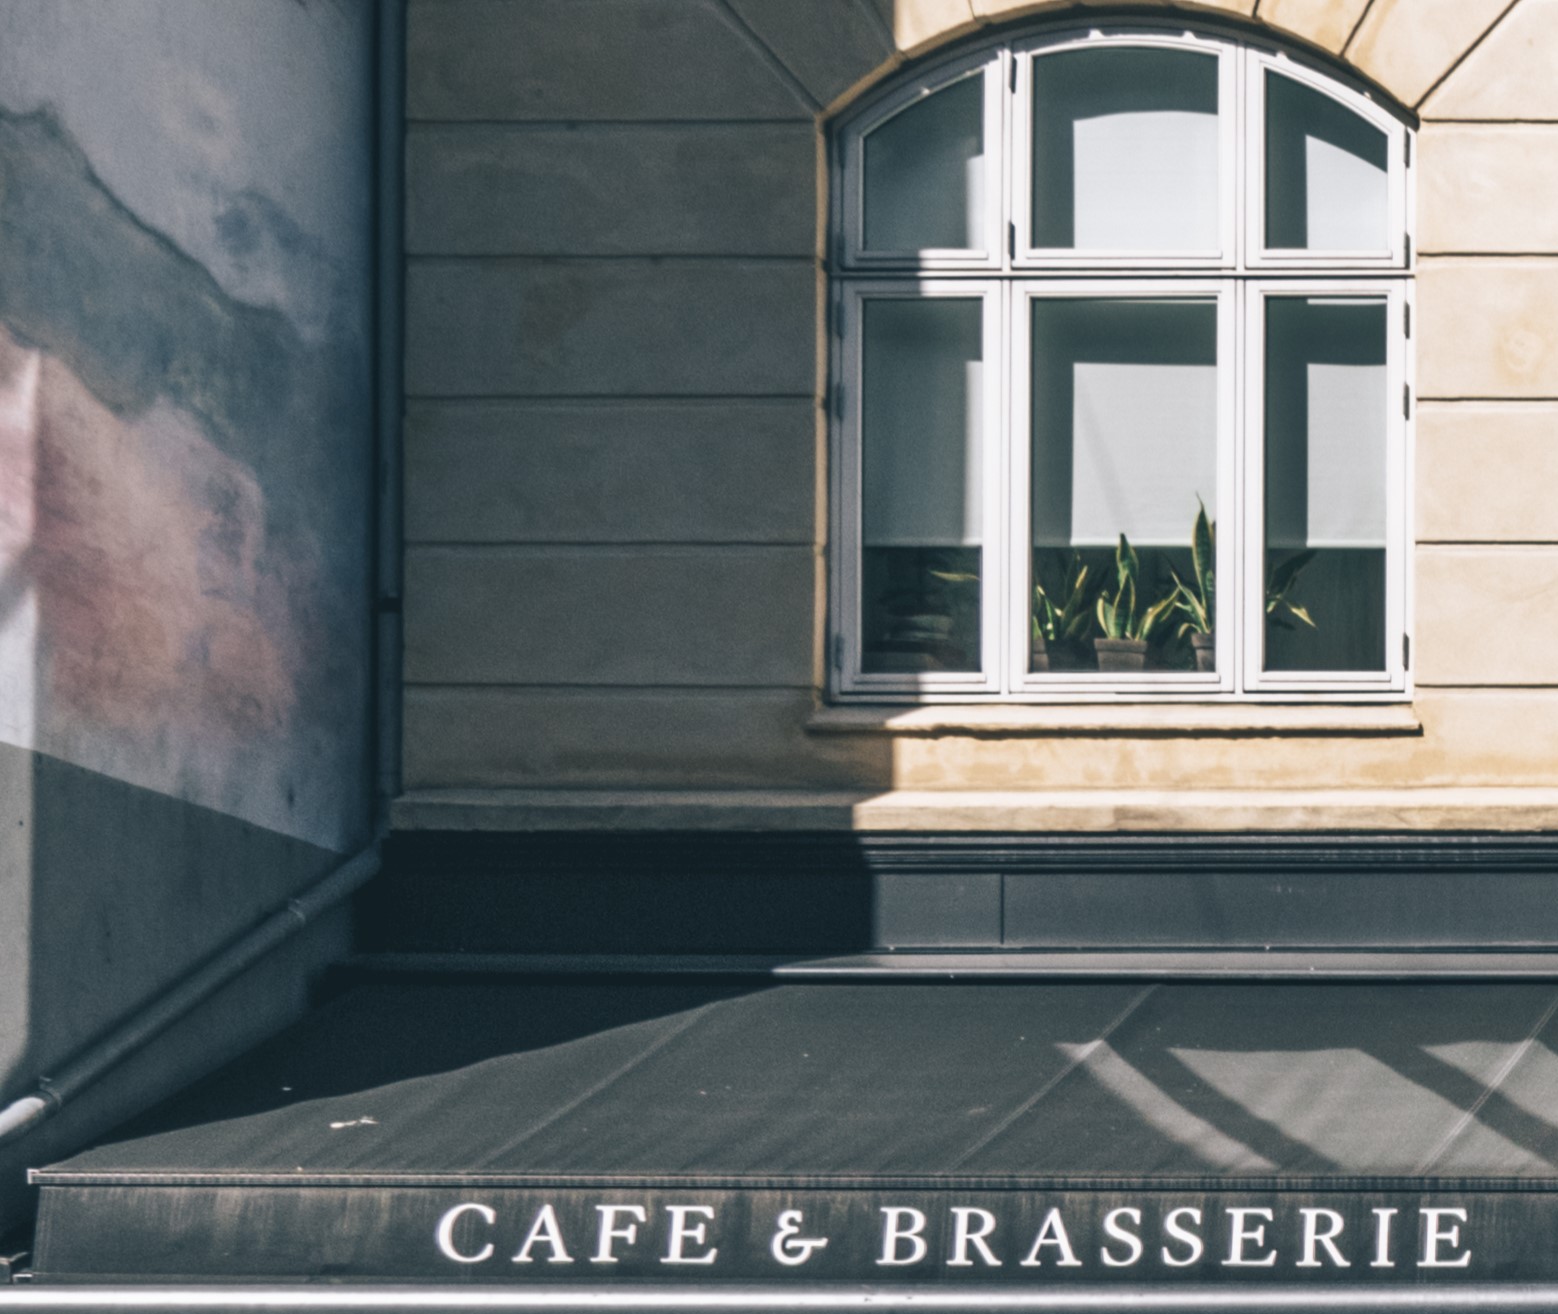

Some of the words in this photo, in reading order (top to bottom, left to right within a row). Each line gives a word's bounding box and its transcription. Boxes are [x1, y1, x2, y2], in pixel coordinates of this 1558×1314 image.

[436, 1202, 719, 1265] CAFE
[772, 1209, 829, 1267] &
[876, 1206, 1472, 1268] BRASSERIE
